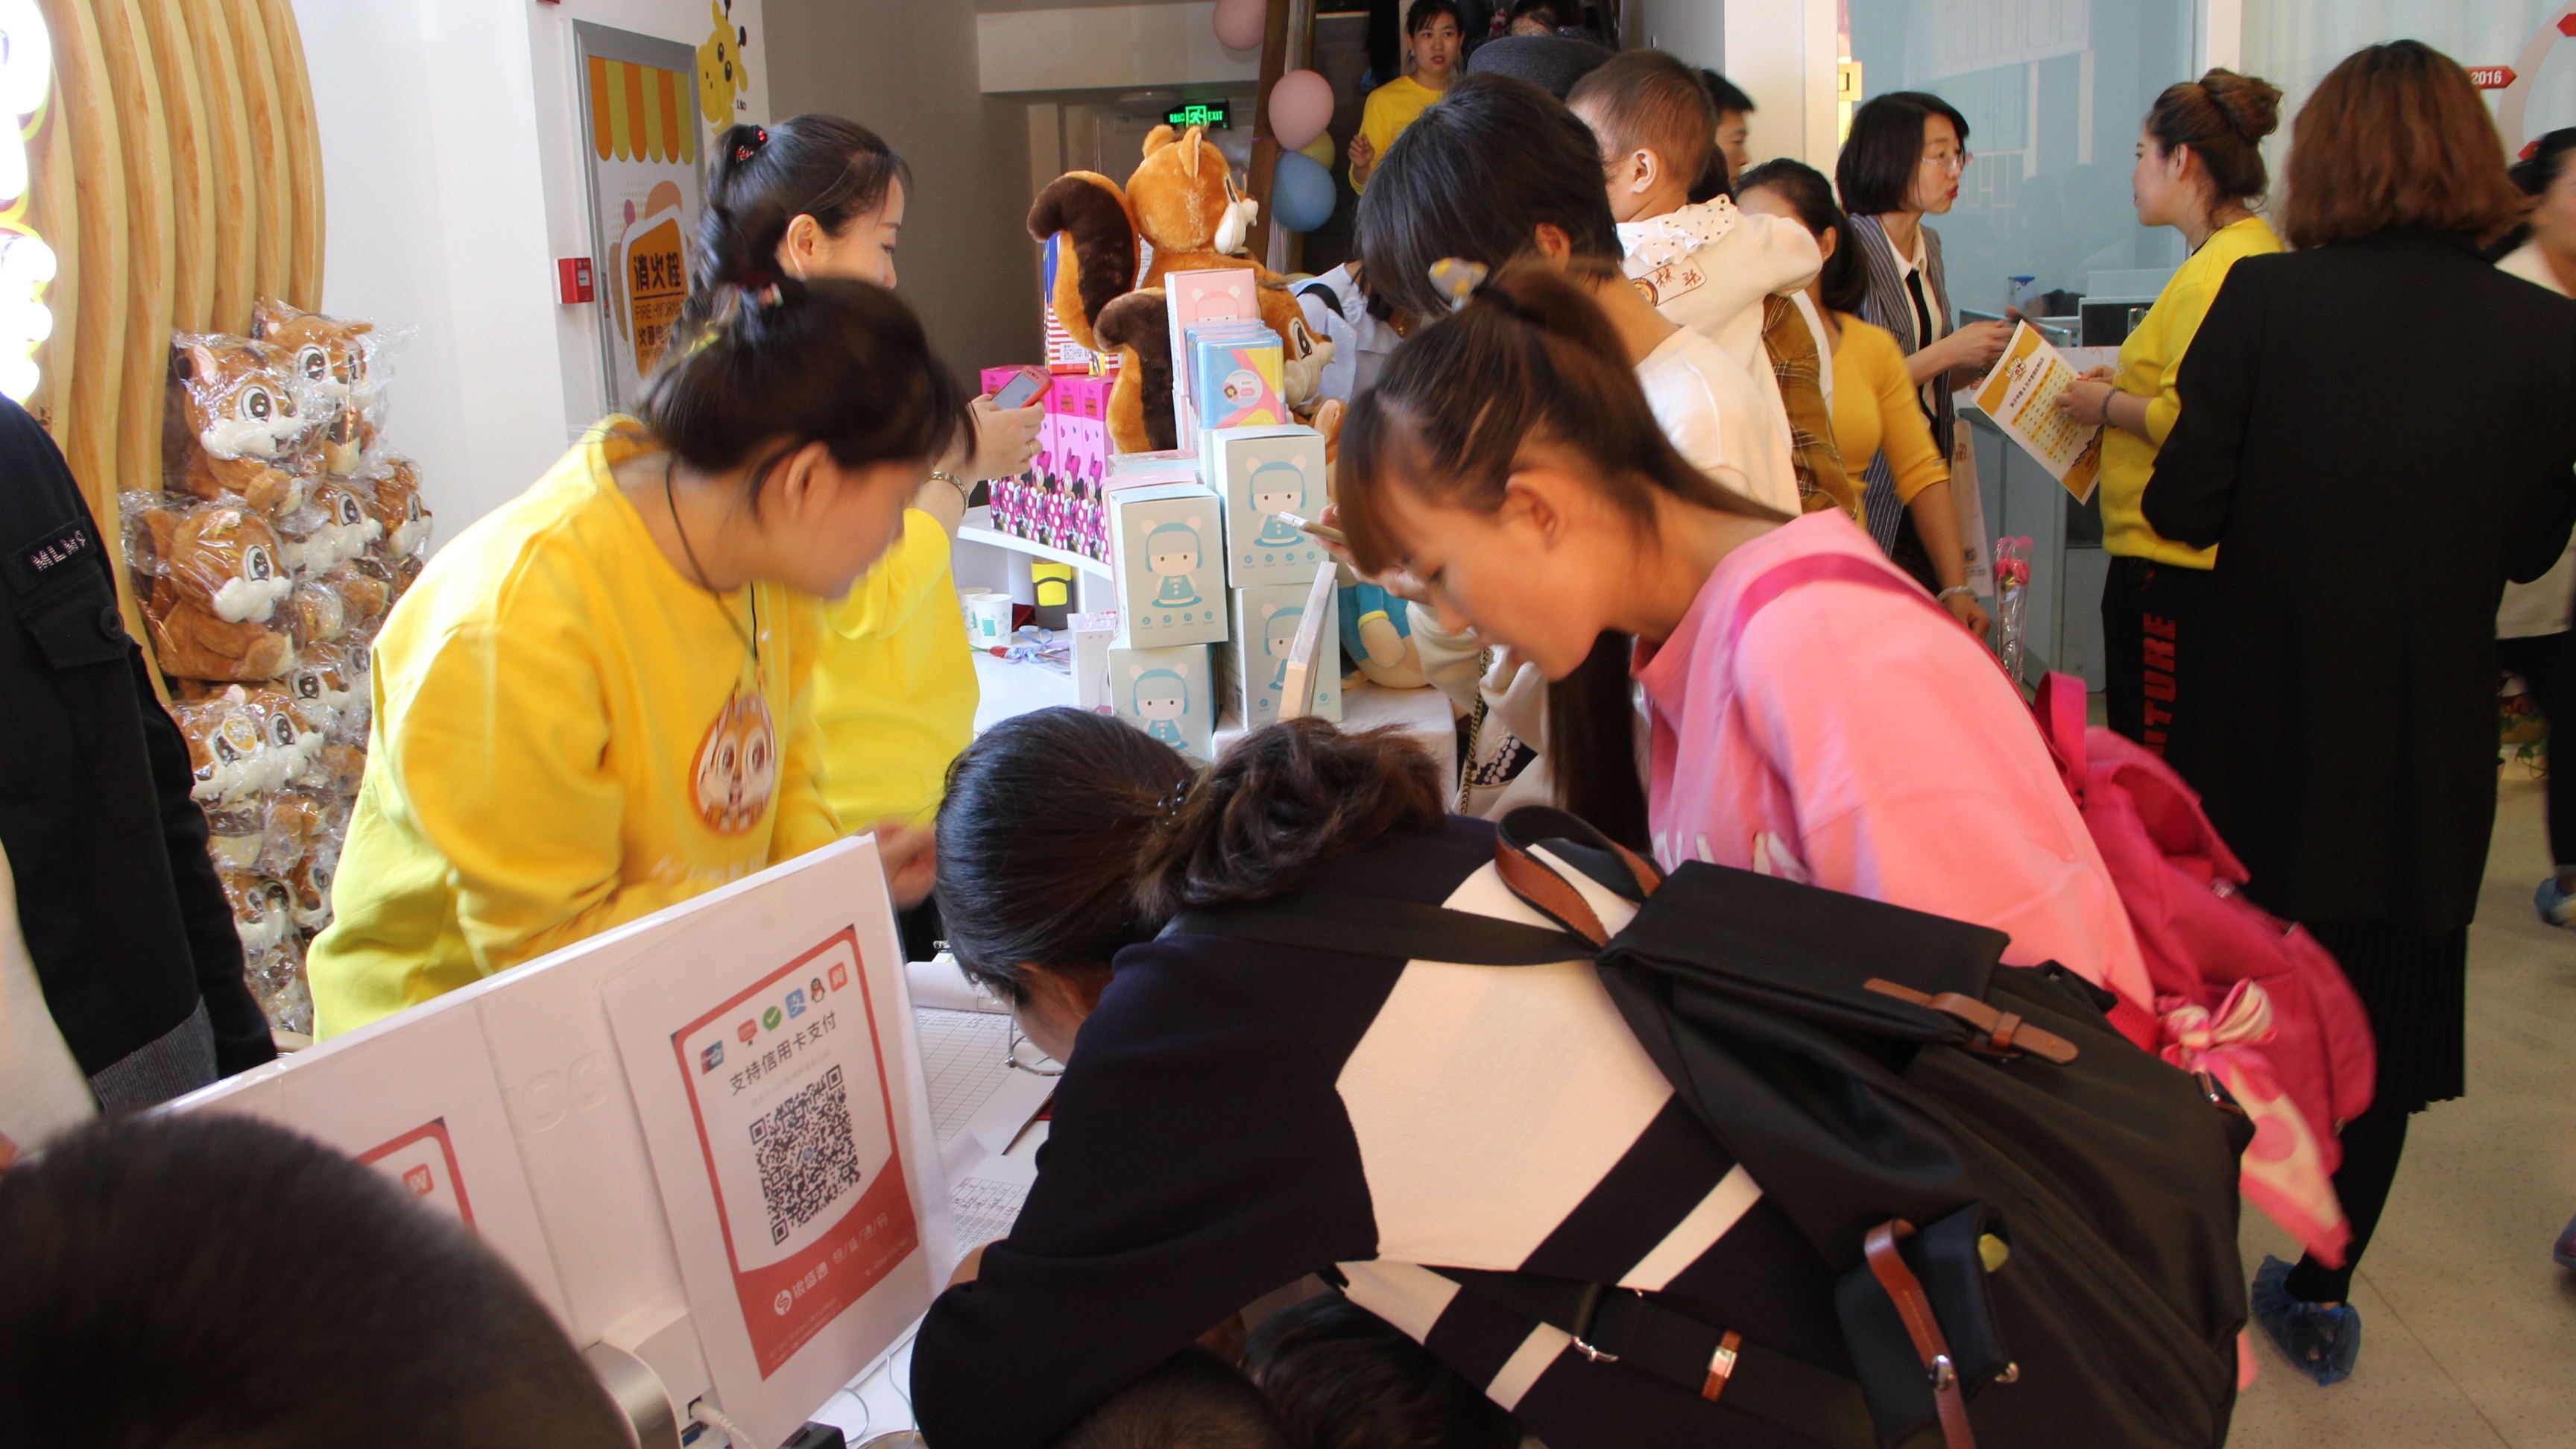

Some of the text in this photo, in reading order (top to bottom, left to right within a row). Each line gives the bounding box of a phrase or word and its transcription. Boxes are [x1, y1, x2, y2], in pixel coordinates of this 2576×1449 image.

[2471, 70, 2502, 85] 2016
[1208, 110, 1223, 121] EXIT
[634, 252, 681, 291] 消火栓
[635, 304, 653, 321] FIRE
[730, 1010, 836, 1096] 支持信用卡支付
